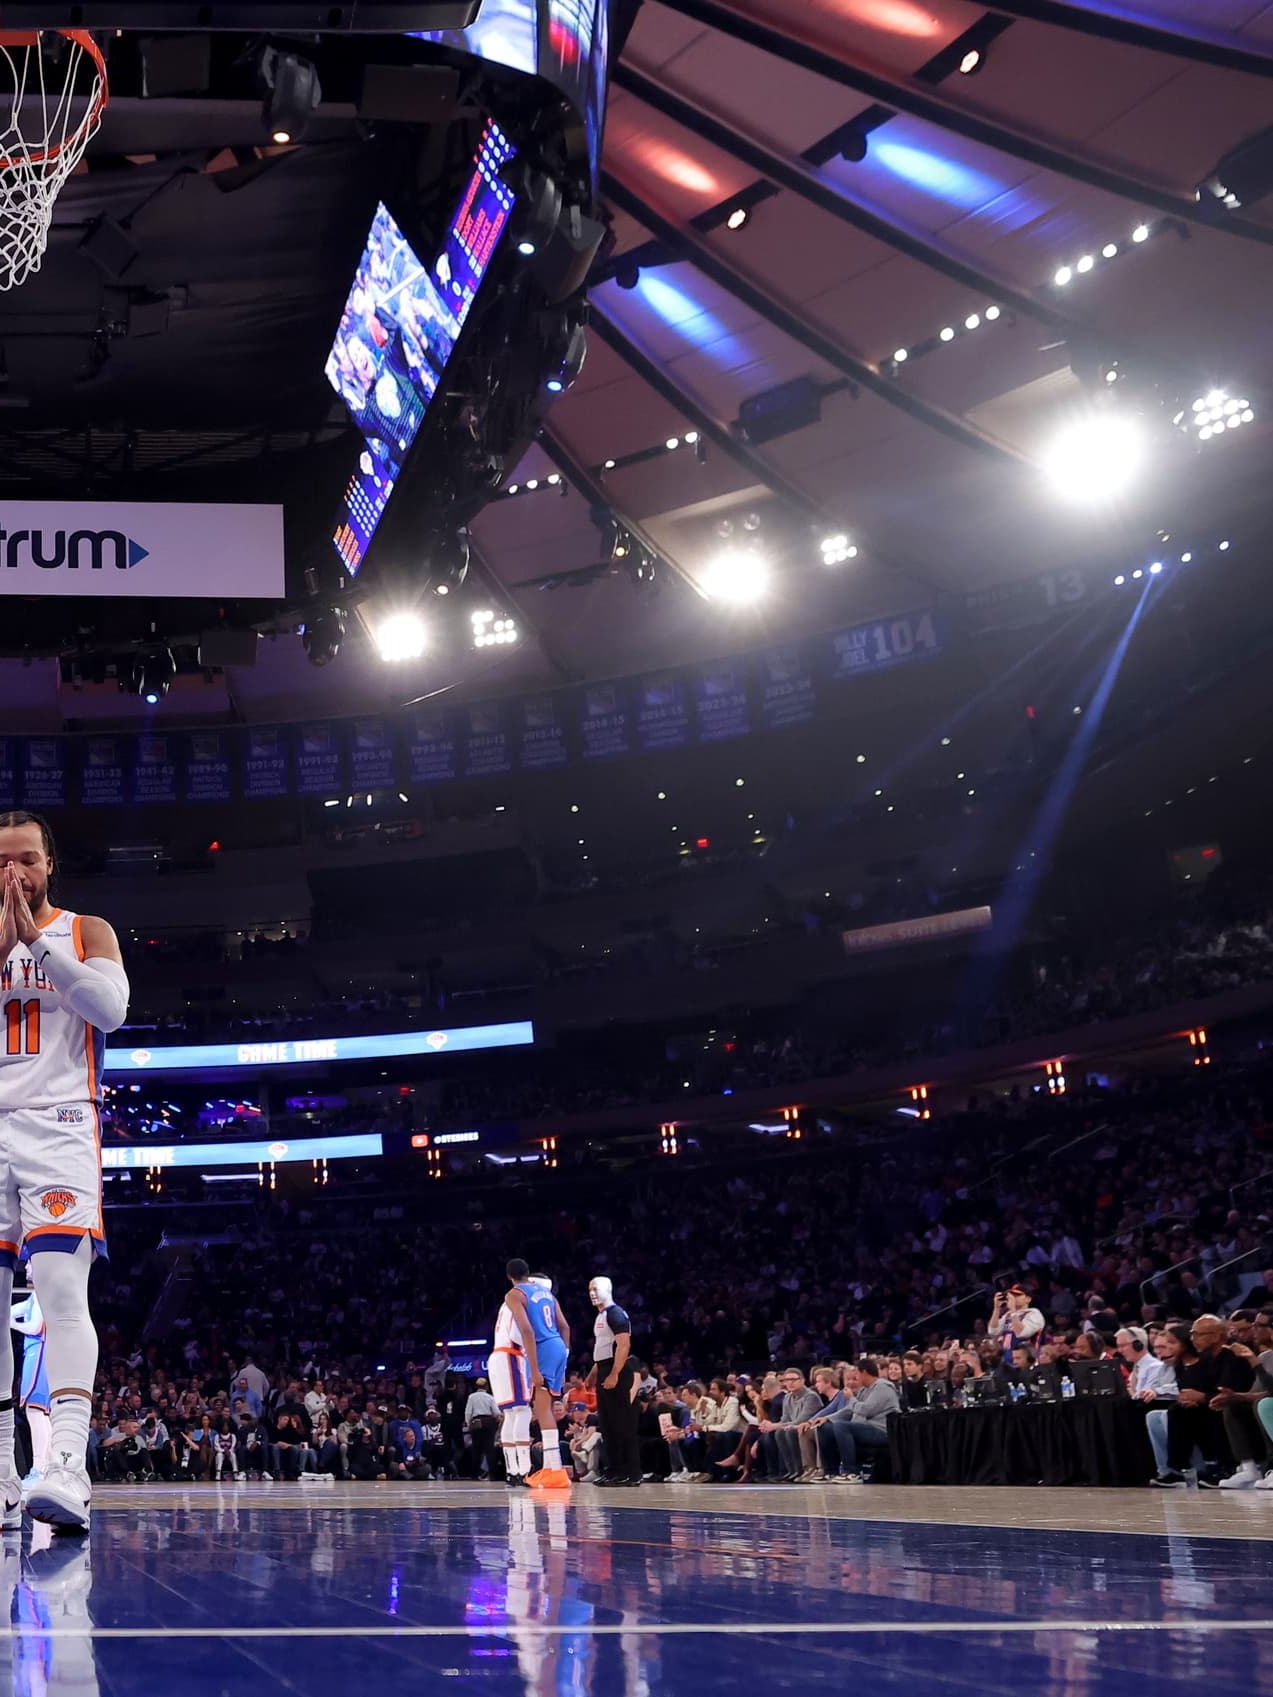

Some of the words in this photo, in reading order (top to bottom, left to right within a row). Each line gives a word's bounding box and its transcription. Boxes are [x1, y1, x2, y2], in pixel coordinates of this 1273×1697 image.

[873, 611, 936, 660] 104
[4, 998, 40, 1055] 11
[237, 1044, 287, 1063] GAME
[294, 1041, 337, 1060] TIME
[56, 1109, 83, 1123] NYC
[103, 1147, 129, 1167] ME
[134, 1146, 176, 1166] TIME
[42, 1190, 76, 1208] KNICKS
[543, 1304, 553, 1329] 8
